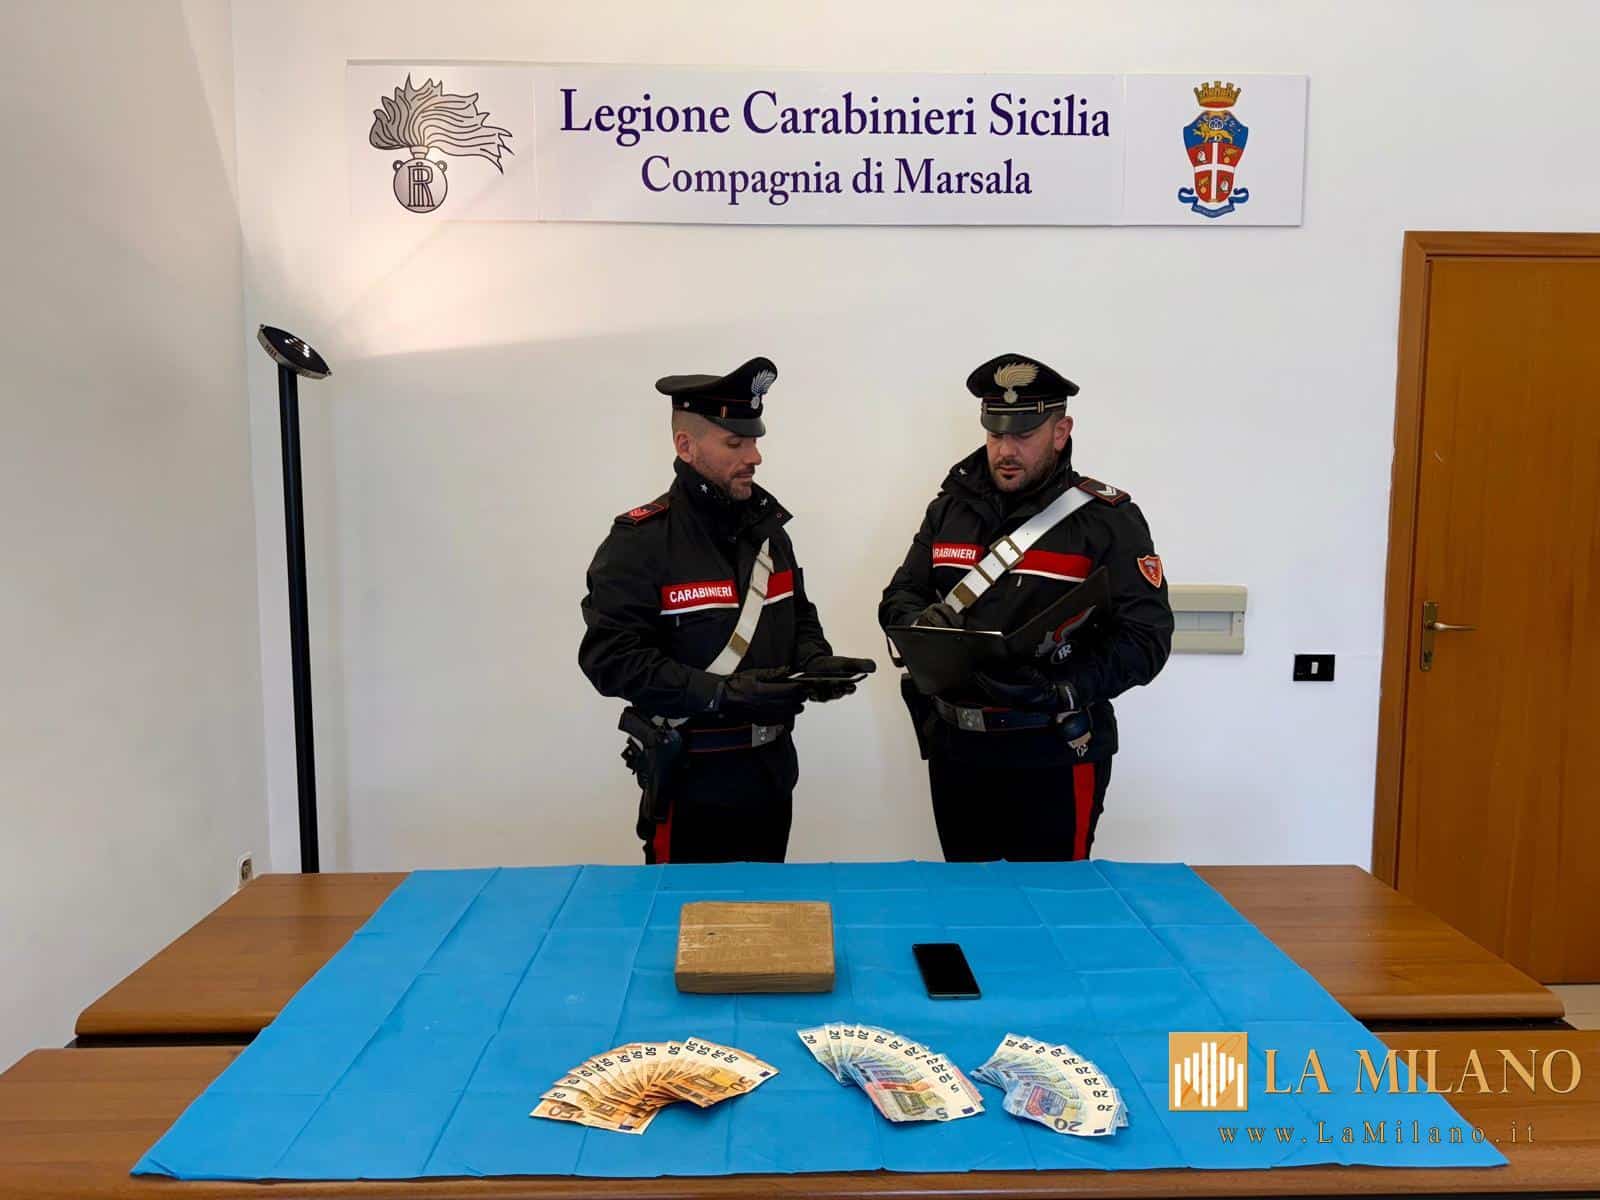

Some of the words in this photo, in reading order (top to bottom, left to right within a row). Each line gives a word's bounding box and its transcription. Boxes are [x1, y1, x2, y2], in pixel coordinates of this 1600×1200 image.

[560, 88, 730, 147] Legione
[743, 90, 977, 135] Carabinieri
[989, 92, 1110, 137] Sicilia
[641, 155, 842, 205] Compagnia
[852, 157, 884, 194] di
[894, 157, 1033, 195] Marsala
[932, 547, 977, 560] RABINIERI
[669, 586, 733, 603] CARABINIERI
[803, 1034, 817, 1044] 20
[829, 1030, 841, 1040] 20
[857, 1030, 869, 1040] 20
[668, 1046, 681, 1055] 50
[685, 1040, 698, 1051] 50
[696, 1045, 711, 1055] 50
[630, 1051, 643, 1059] 50
[645, 1047, 657, 1056] 50
[904, 1046, 919, 1056] 20
[599, 1057, 614, 1067] 50
[617, 1054, 631, 1063] 50
[723, 1054, 739, 1063] 50
[931, 1064, 947, 1073] 20
[1075, 1066, 1091, 1074] 20
[730, 1075, 756, 1091] 50
[938, 1073, 953, 1083] 10
[1083, 1077, 1101, 1086] 20
[950, 1083, 960, 1093] 5
[1092, 1090, 1109, 1098] 20
[935, 1107, 949, 1119] 5
[1054, 1118, 1083, 1132] 20
